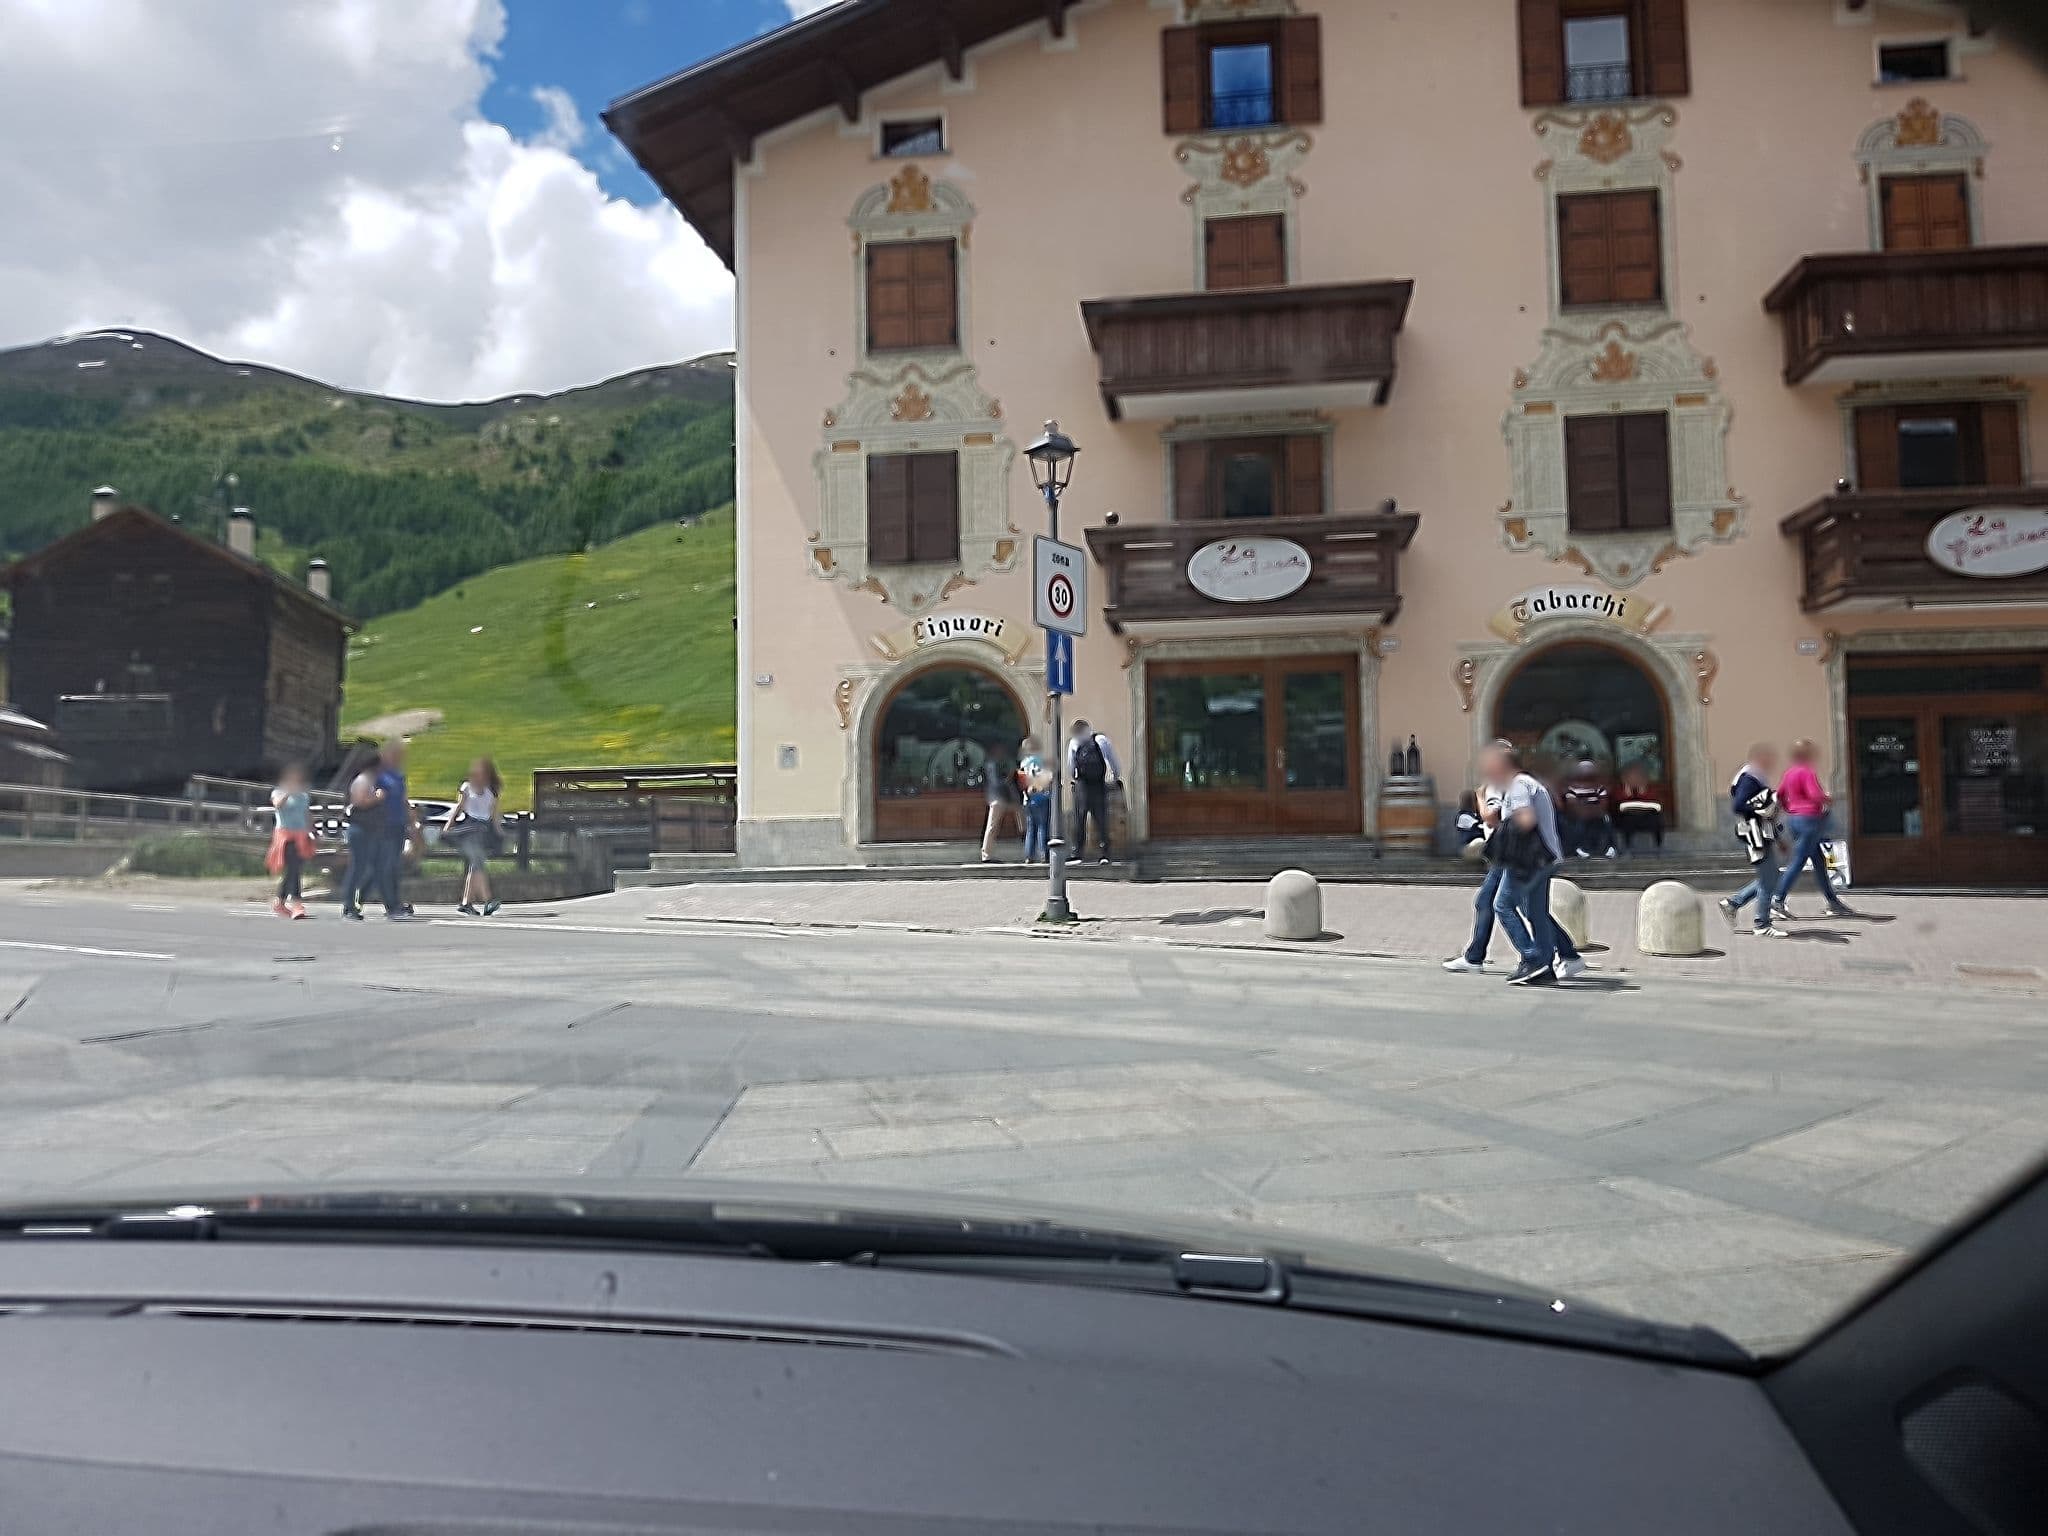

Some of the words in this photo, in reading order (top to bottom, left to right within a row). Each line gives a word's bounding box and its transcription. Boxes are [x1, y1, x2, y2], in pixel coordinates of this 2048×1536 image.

[1055, 586, 1067, 606] 30
[1510, 589, 1627, 623] Tabacchi
[913, 617, 1004, 643] Liquori
